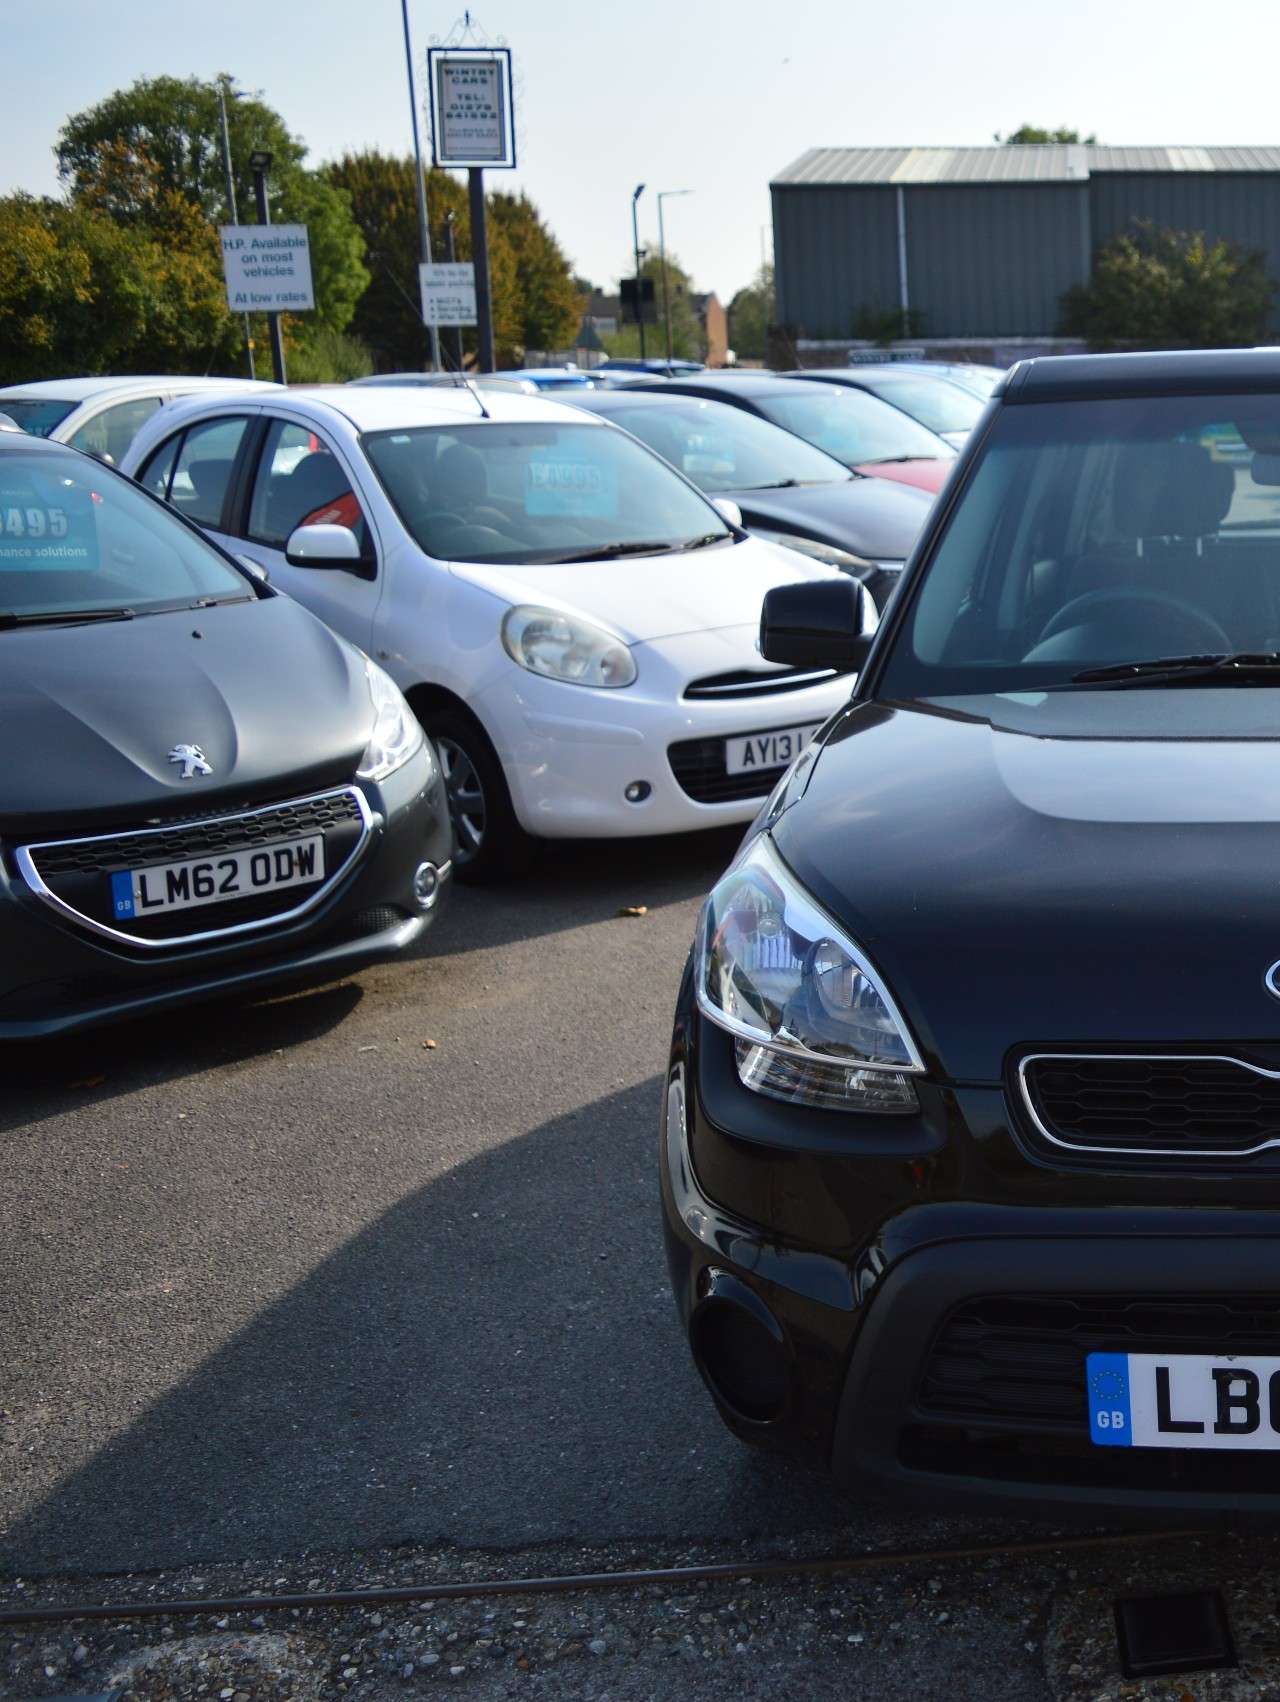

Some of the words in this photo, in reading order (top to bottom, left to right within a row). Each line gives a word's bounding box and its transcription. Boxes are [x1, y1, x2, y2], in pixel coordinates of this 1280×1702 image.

[445, 68, 494, 76] WINTRY
[451, 77, 488, 85] CARS
[251, 235, 307, 249] Available
[241, 254, 258, 263] on
[262, 252, 293, 263] most
[243, 265, 295, 277] vehicles
[235, 291, 248, 304] At
[250, 291, 272, 303] low
[276, 290, 308, 302] rates
[0, 508, 69, 537] 495
[35, 546, 88, 557] solutions
[742, 734, 792, 767] AY13
[139, 858, 240, 908] LM62
[250, 843, 316, 887] ODW
[117, 900, 131, 911] GB
[1096, 1411, 1126, 1429] GB
